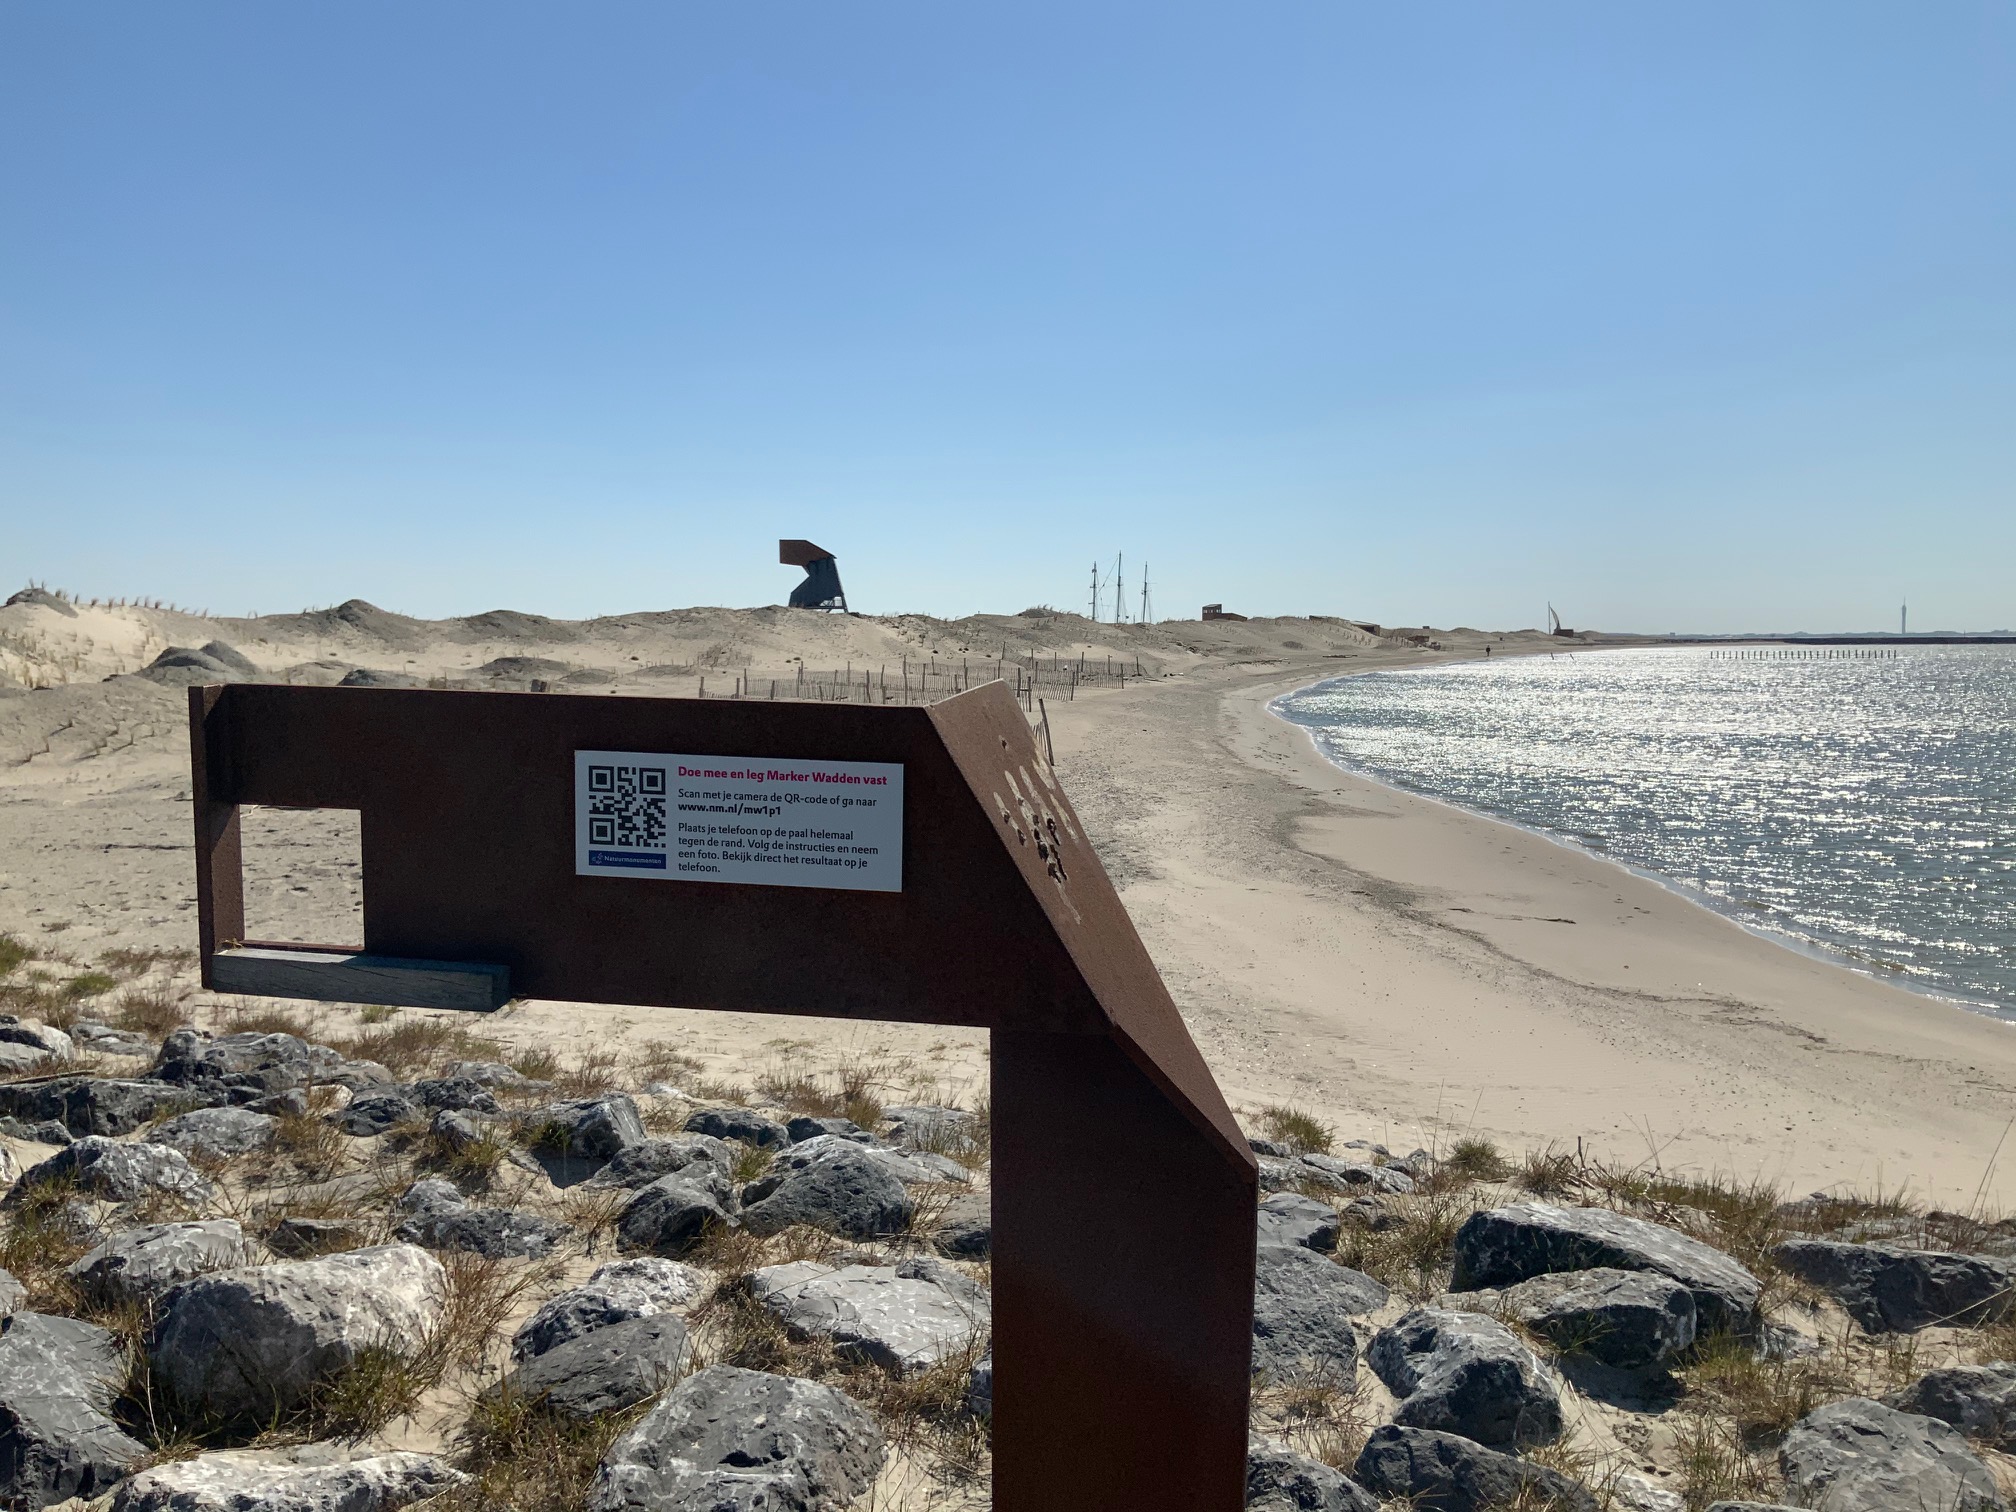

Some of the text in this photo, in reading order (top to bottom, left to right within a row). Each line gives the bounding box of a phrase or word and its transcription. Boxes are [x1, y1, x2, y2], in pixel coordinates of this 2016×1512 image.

[678, 766, 888, 785] Doe mee en leg Marker Wadden vast
[678, 789, 877, 808] Scan met je camera de QR-code of ga naar
[678, 802, 781, 817] www.nm.nl/mw1p1
[678, 823, 853, 840] Plaats je telefoon op de paal helemaal
[678, 837, 878, 855] tegen de rand. Volg de instructies en neem
[678, 850, 867, 869] een foto. Bekijk direct het resultaat op je
[678, 862, 721, 873] telefoon.
